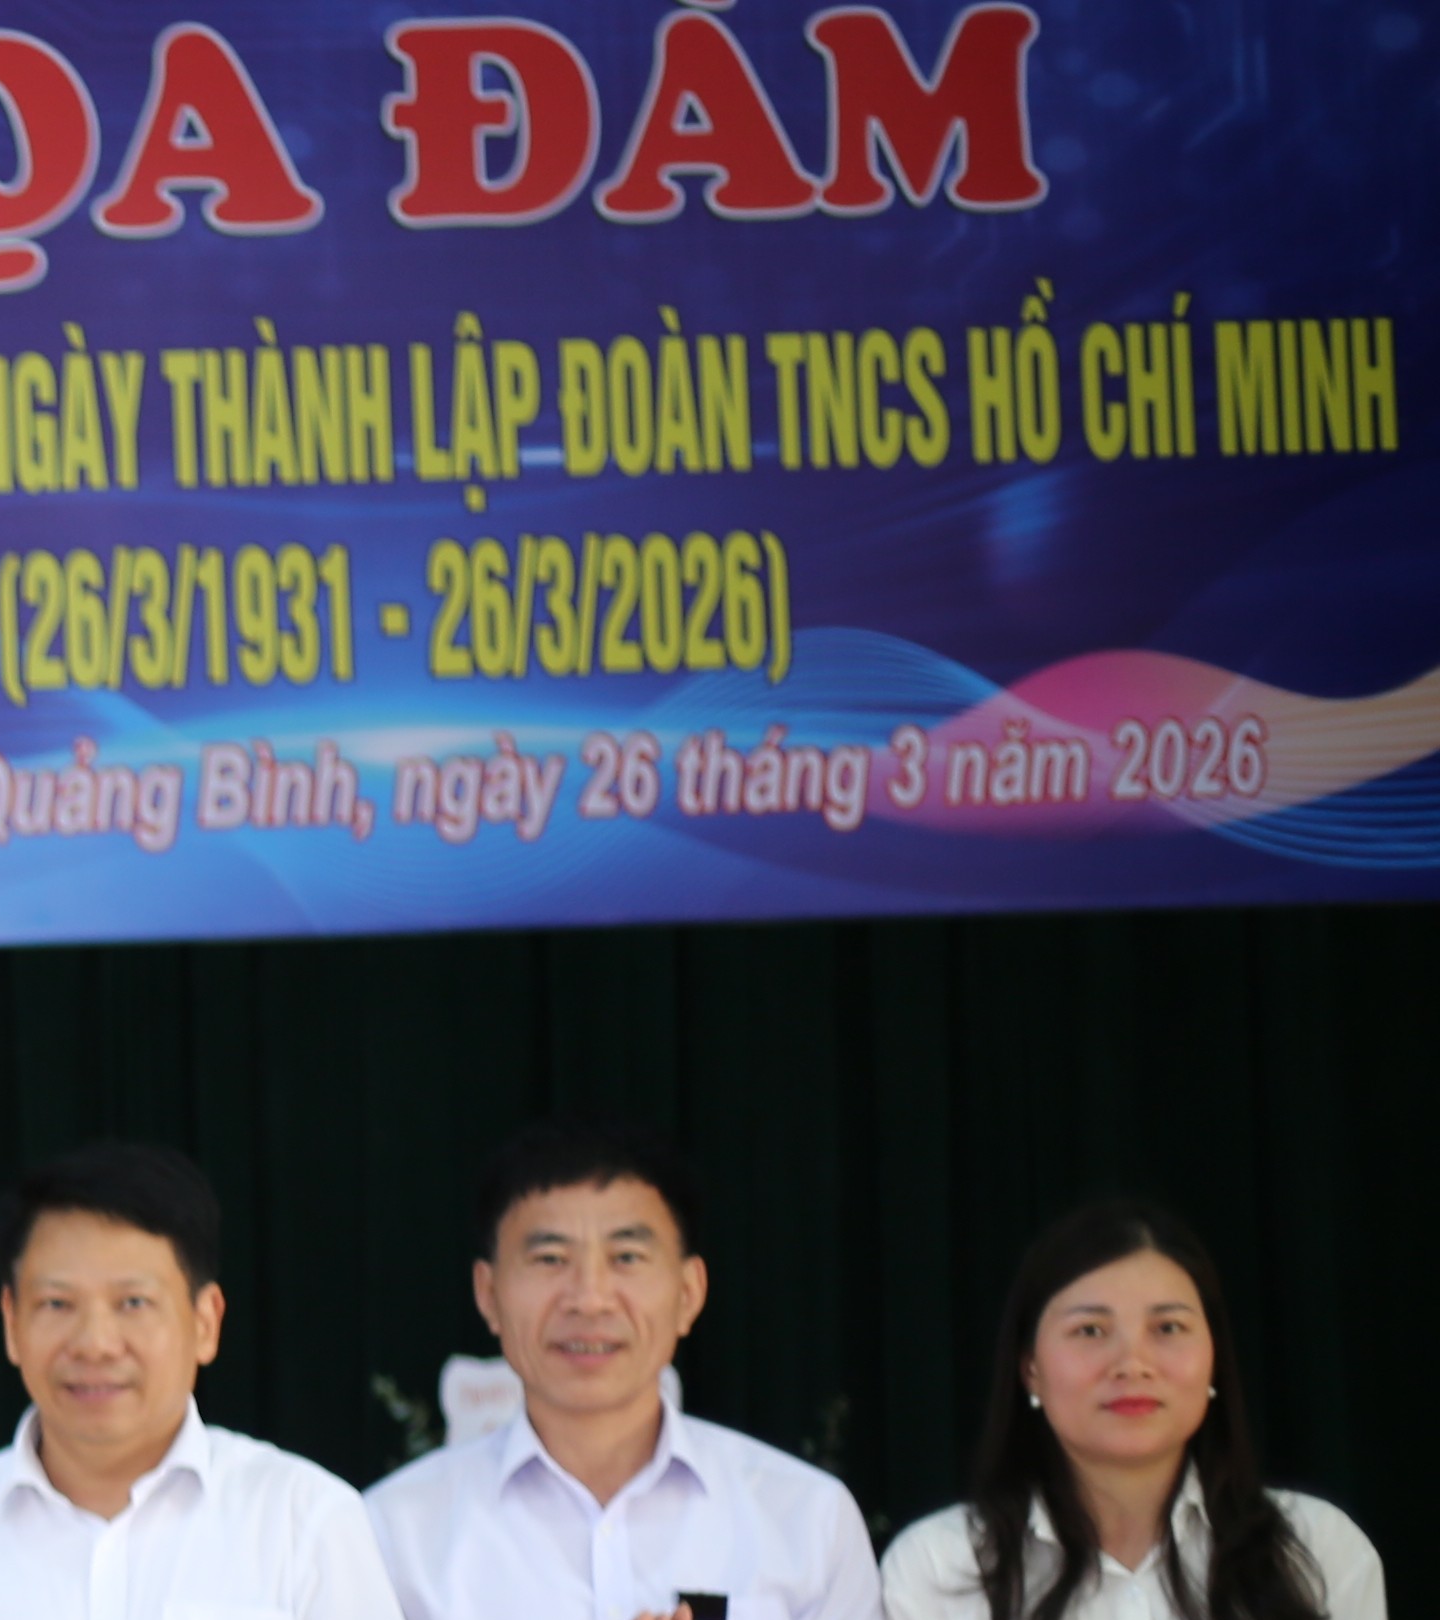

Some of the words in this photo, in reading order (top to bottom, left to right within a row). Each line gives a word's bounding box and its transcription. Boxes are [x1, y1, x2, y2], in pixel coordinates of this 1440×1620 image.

[160, 316, 394, 488] THÀNH
[409, 311, 540, 512] LẬP
[558, 304, 752, 476] ĐOÀN
[766, 327, 950, 470] TNCS
[967, 276, 1062, 464] HỒ
[1080, 292, 1195, 461] CHÍ
[1214, 318, 1398, 456] MINH
[427, 530, 790, 685] 26/3/2026)
[198, 739, 375, 839] Bình,
[394, 731, 567, 843] ngày
[581, 731, 661, 818] 26
[680, 725, 869, 831] tháng
[888, 724, 927, 807] 3
[946, 718, 1087, 806] năm
[1111, 715, 1267, 797] 2026
